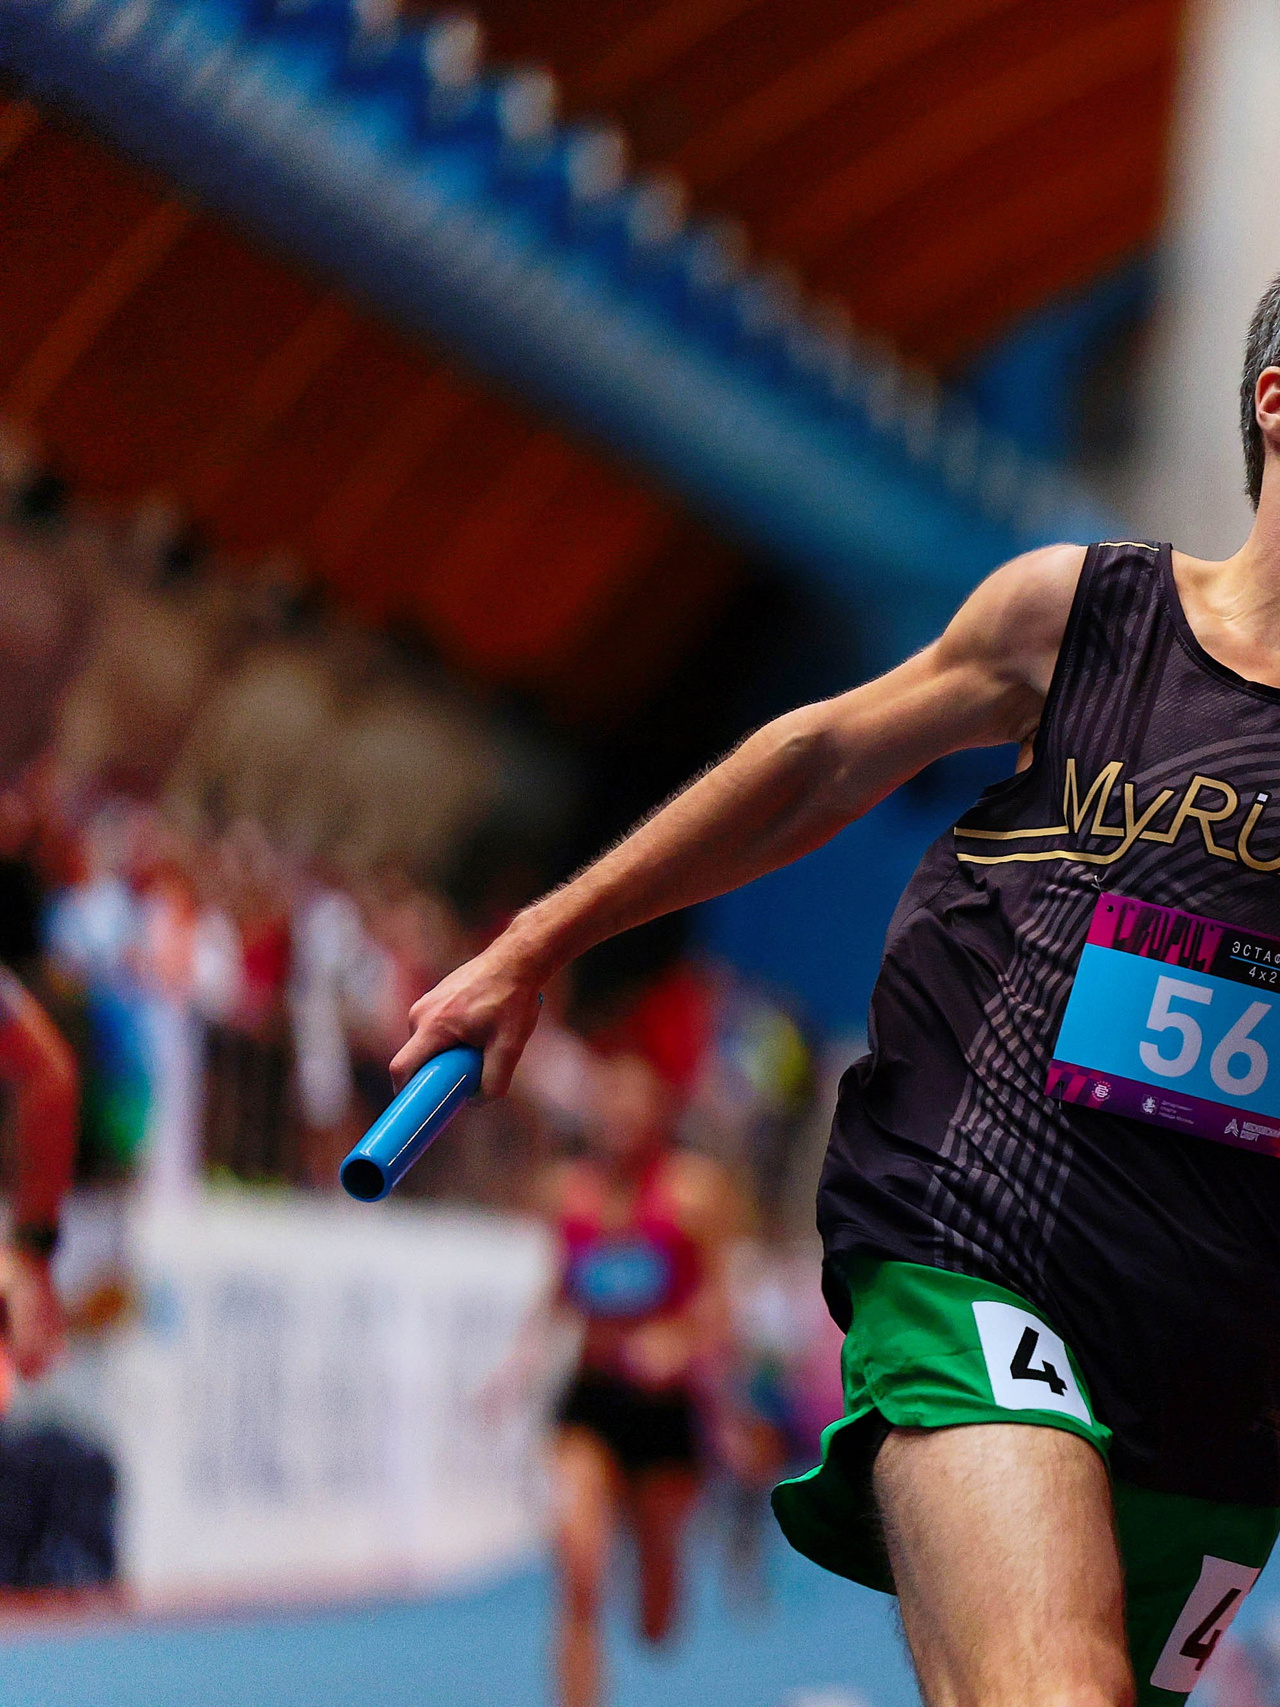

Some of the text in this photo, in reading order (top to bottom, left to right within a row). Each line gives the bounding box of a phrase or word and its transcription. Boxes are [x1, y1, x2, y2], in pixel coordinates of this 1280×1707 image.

[1138, 974, 1272, 1096] 56
[1009, 1325, 1069, 1397] 4
[1179, 1587, 1242, 1672] 4
